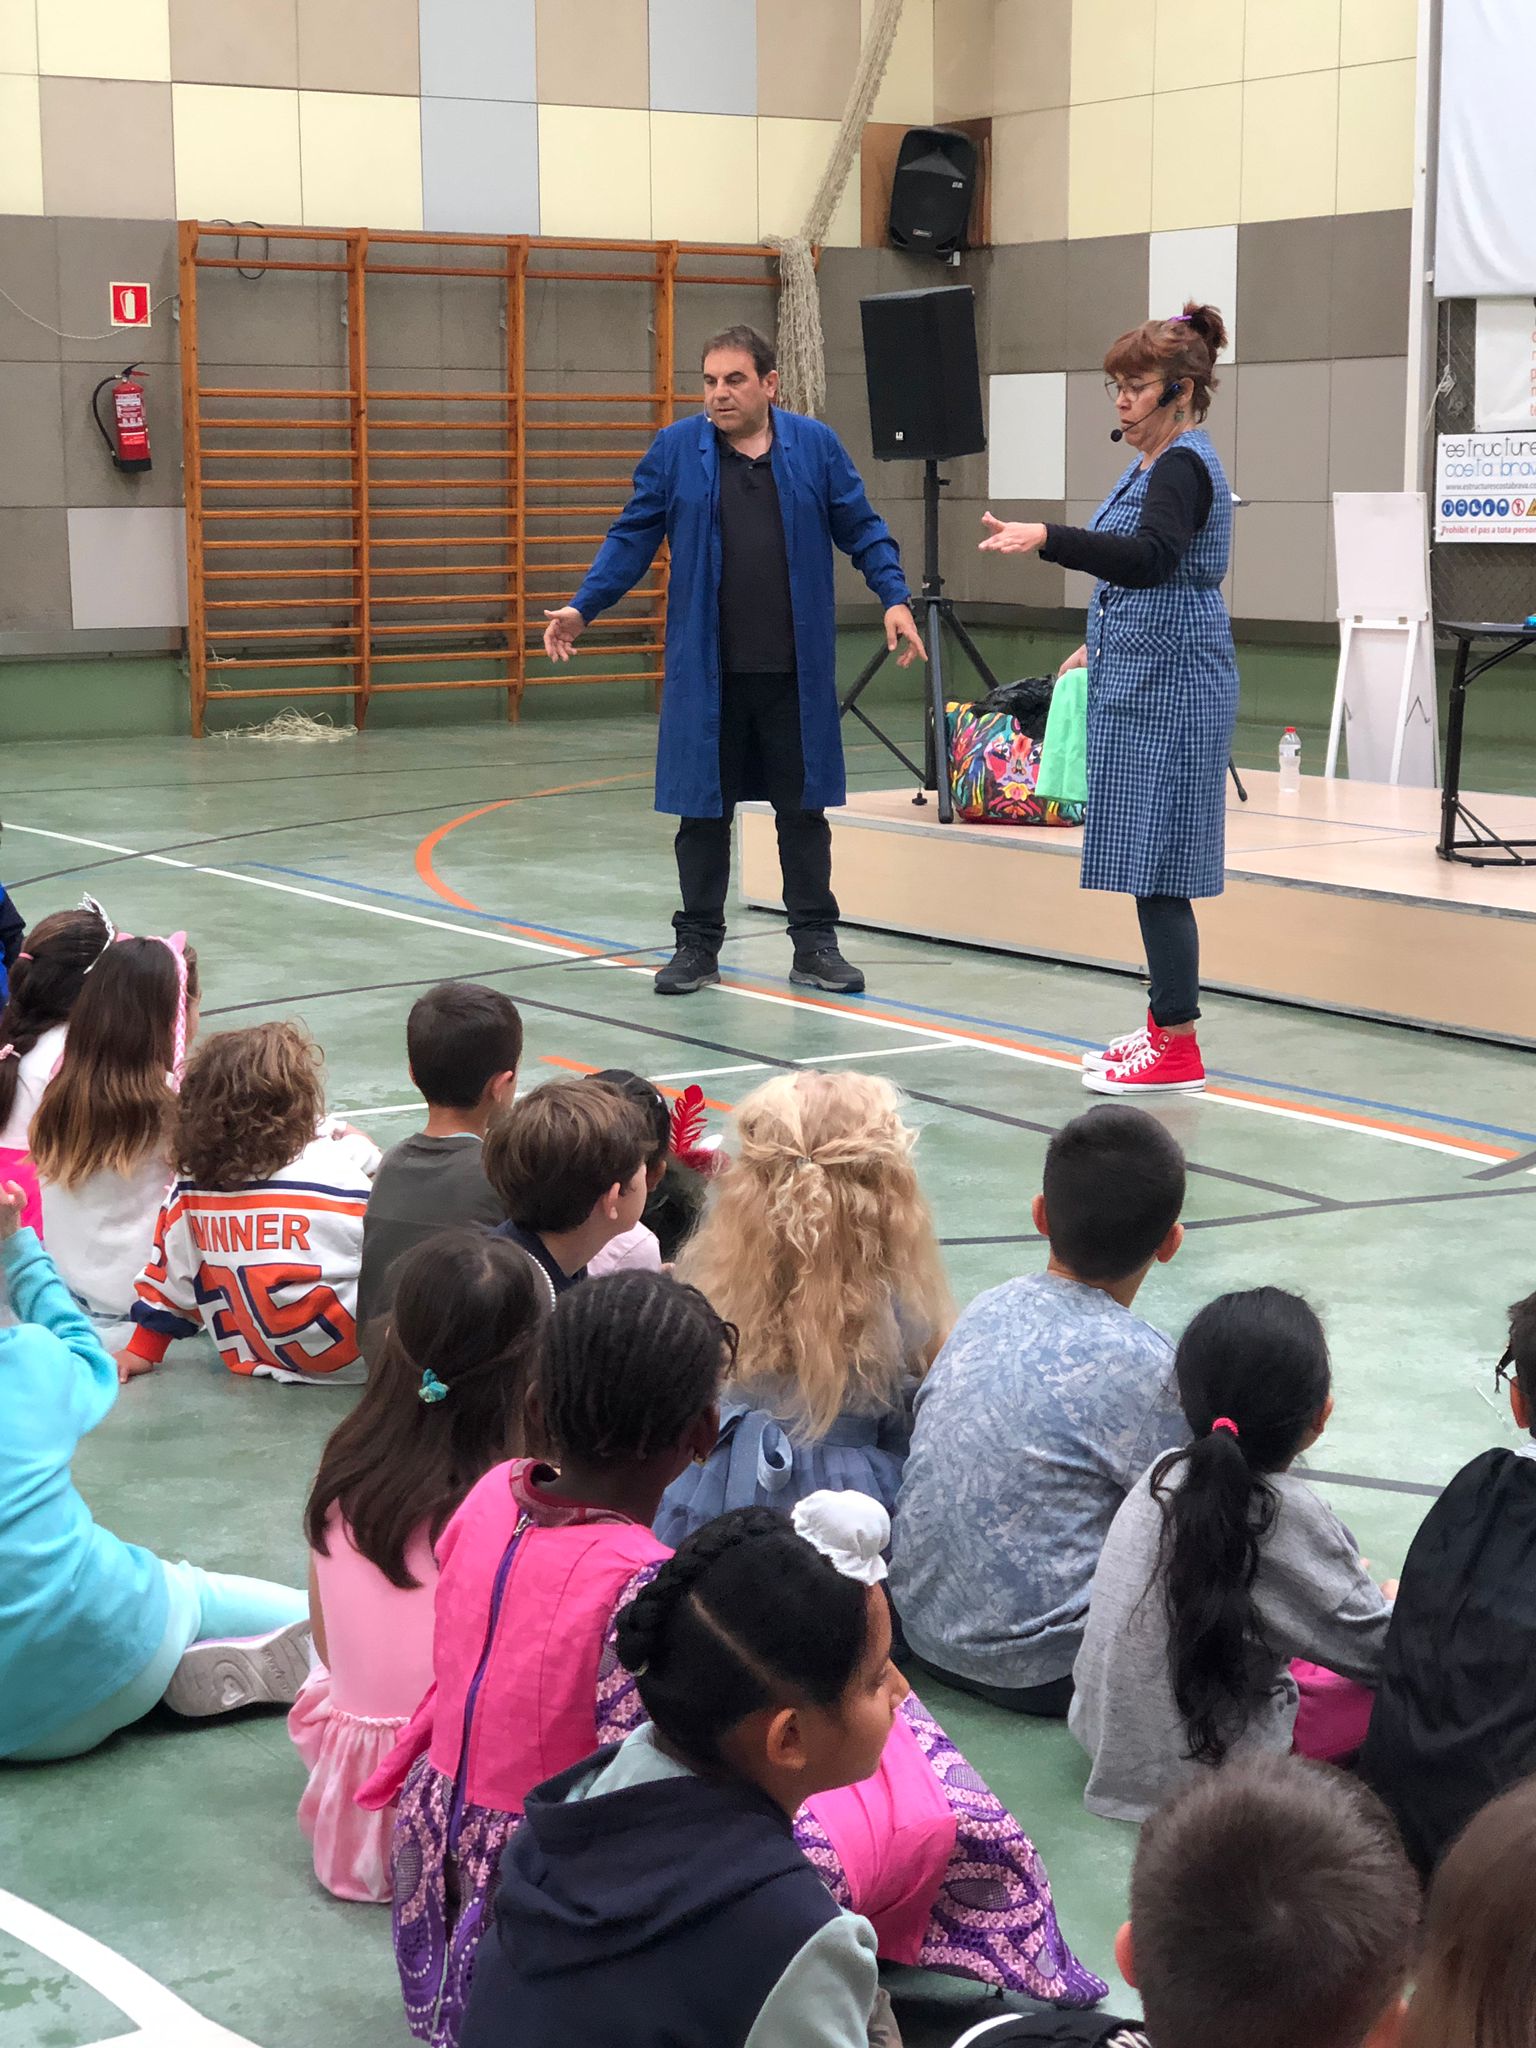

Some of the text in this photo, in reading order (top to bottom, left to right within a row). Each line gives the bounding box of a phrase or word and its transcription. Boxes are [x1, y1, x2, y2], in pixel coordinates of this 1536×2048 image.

[1445, 458, 1493, 477] costa
[1441, 526, 1469, 535] Prohibit
[1470, 525, 1477, 534] el
[1478, 527, 1491, 536] pas
[1497, 526, 1511, 534] tota
